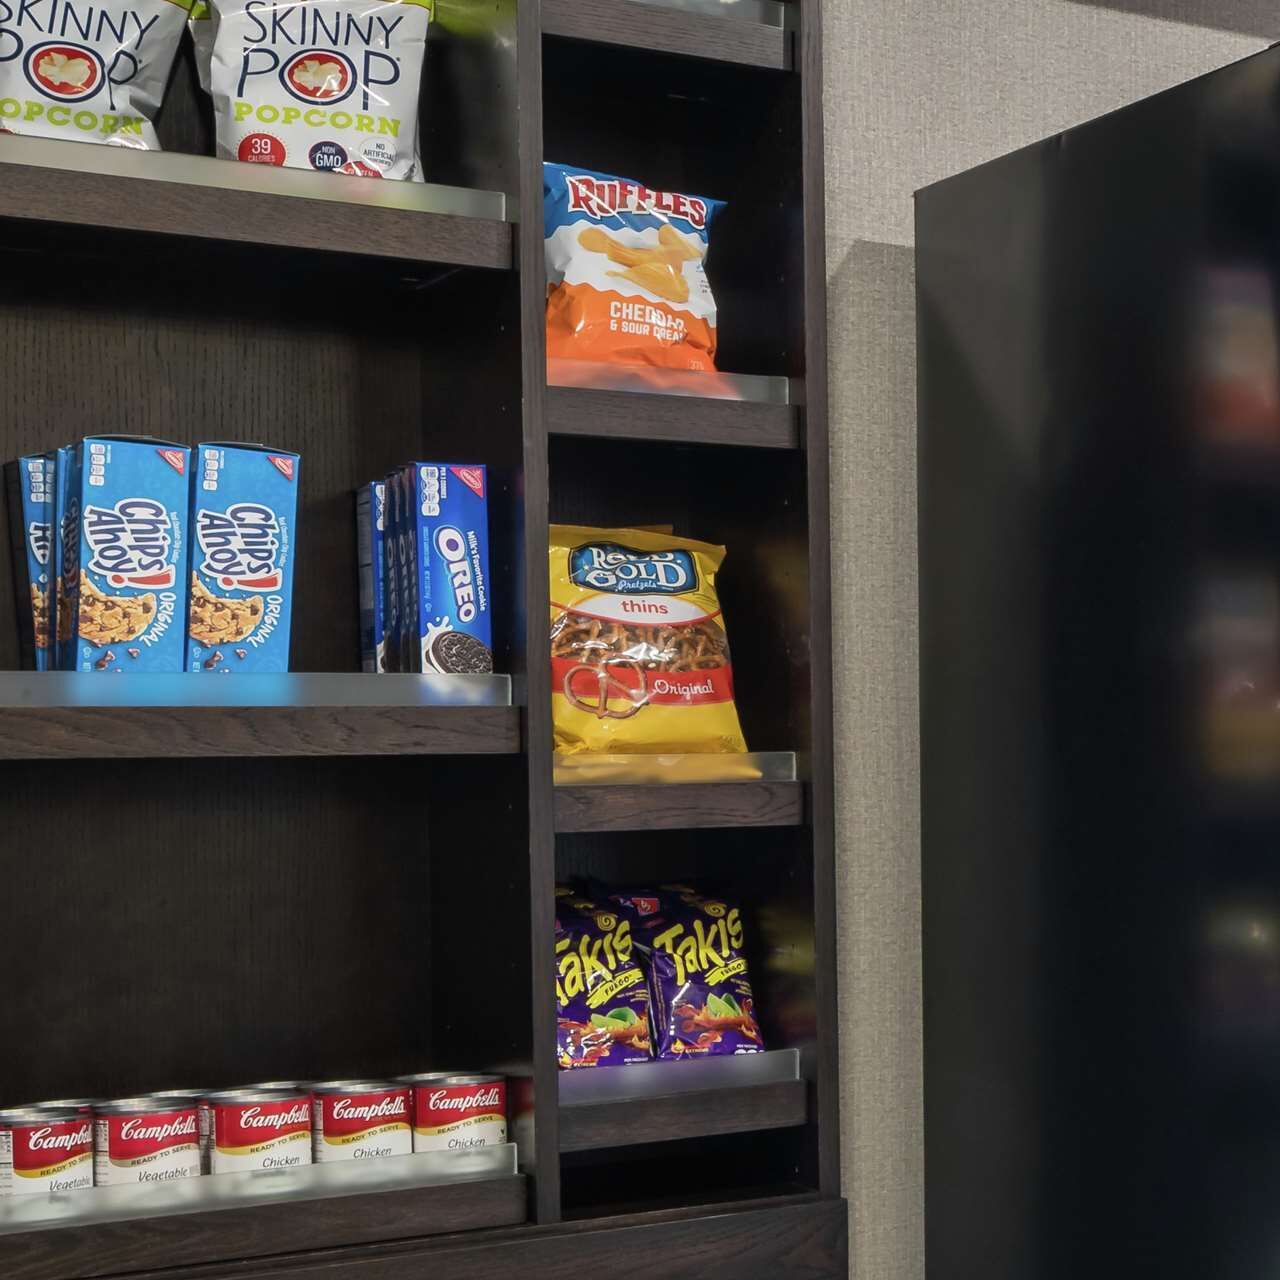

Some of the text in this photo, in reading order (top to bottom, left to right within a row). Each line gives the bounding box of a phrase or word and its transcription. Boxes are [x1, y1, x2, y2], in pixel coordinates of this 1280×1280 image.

[243, 1, 403, 49] SKINNY
[237, 47, 402, 111] POP
[233, 102, 401, 136] POPCORN
[252, 138, 272, 155] 39
[315, 155, 342, 168] GMO
[567, 176, 705, 228] RUFFLES
[621, 322, 650, 336] SOUR
[116, 499, 168, 577] Chips
[228, 503, 280, 579] Chips
[436, 526, 477, 624] OREO
[466, 530, 487, 611] Milk's Favorite Cookie
[587, 560, 687, 588] GOLD
[617, 579, 657, 590] Pretzels
[621, 600, 668, 615] thins
[140, 592, 176, 647] ORIGINAL
[246, 594, 283, 648] ORIGINAL
[654, 679, 714, 700] Original
[333, 1096, 407, 1122] Campbell's
[429, 1088, 501, 1111] Campbell's
[121, 1116, 197, 1141] Campbell's
[342, 1135, 365, 1144] READY
[379, 1124, 400, 1134] SERVE
[437, 1116, 493, 1135] READY TO SERVE
[250, 1143, 275, 1153] READY
[289, 1133, 307, 1142] SERVE
[353, 1147, 392, 1159] Chicken
[447, 1137, 486, 1149] Chicken
[131, 1144, 192, 1167] READY TO SERVE
[262, 1156, 300, 1168] Chicken
[40, 1164, 66, 1178] READY
